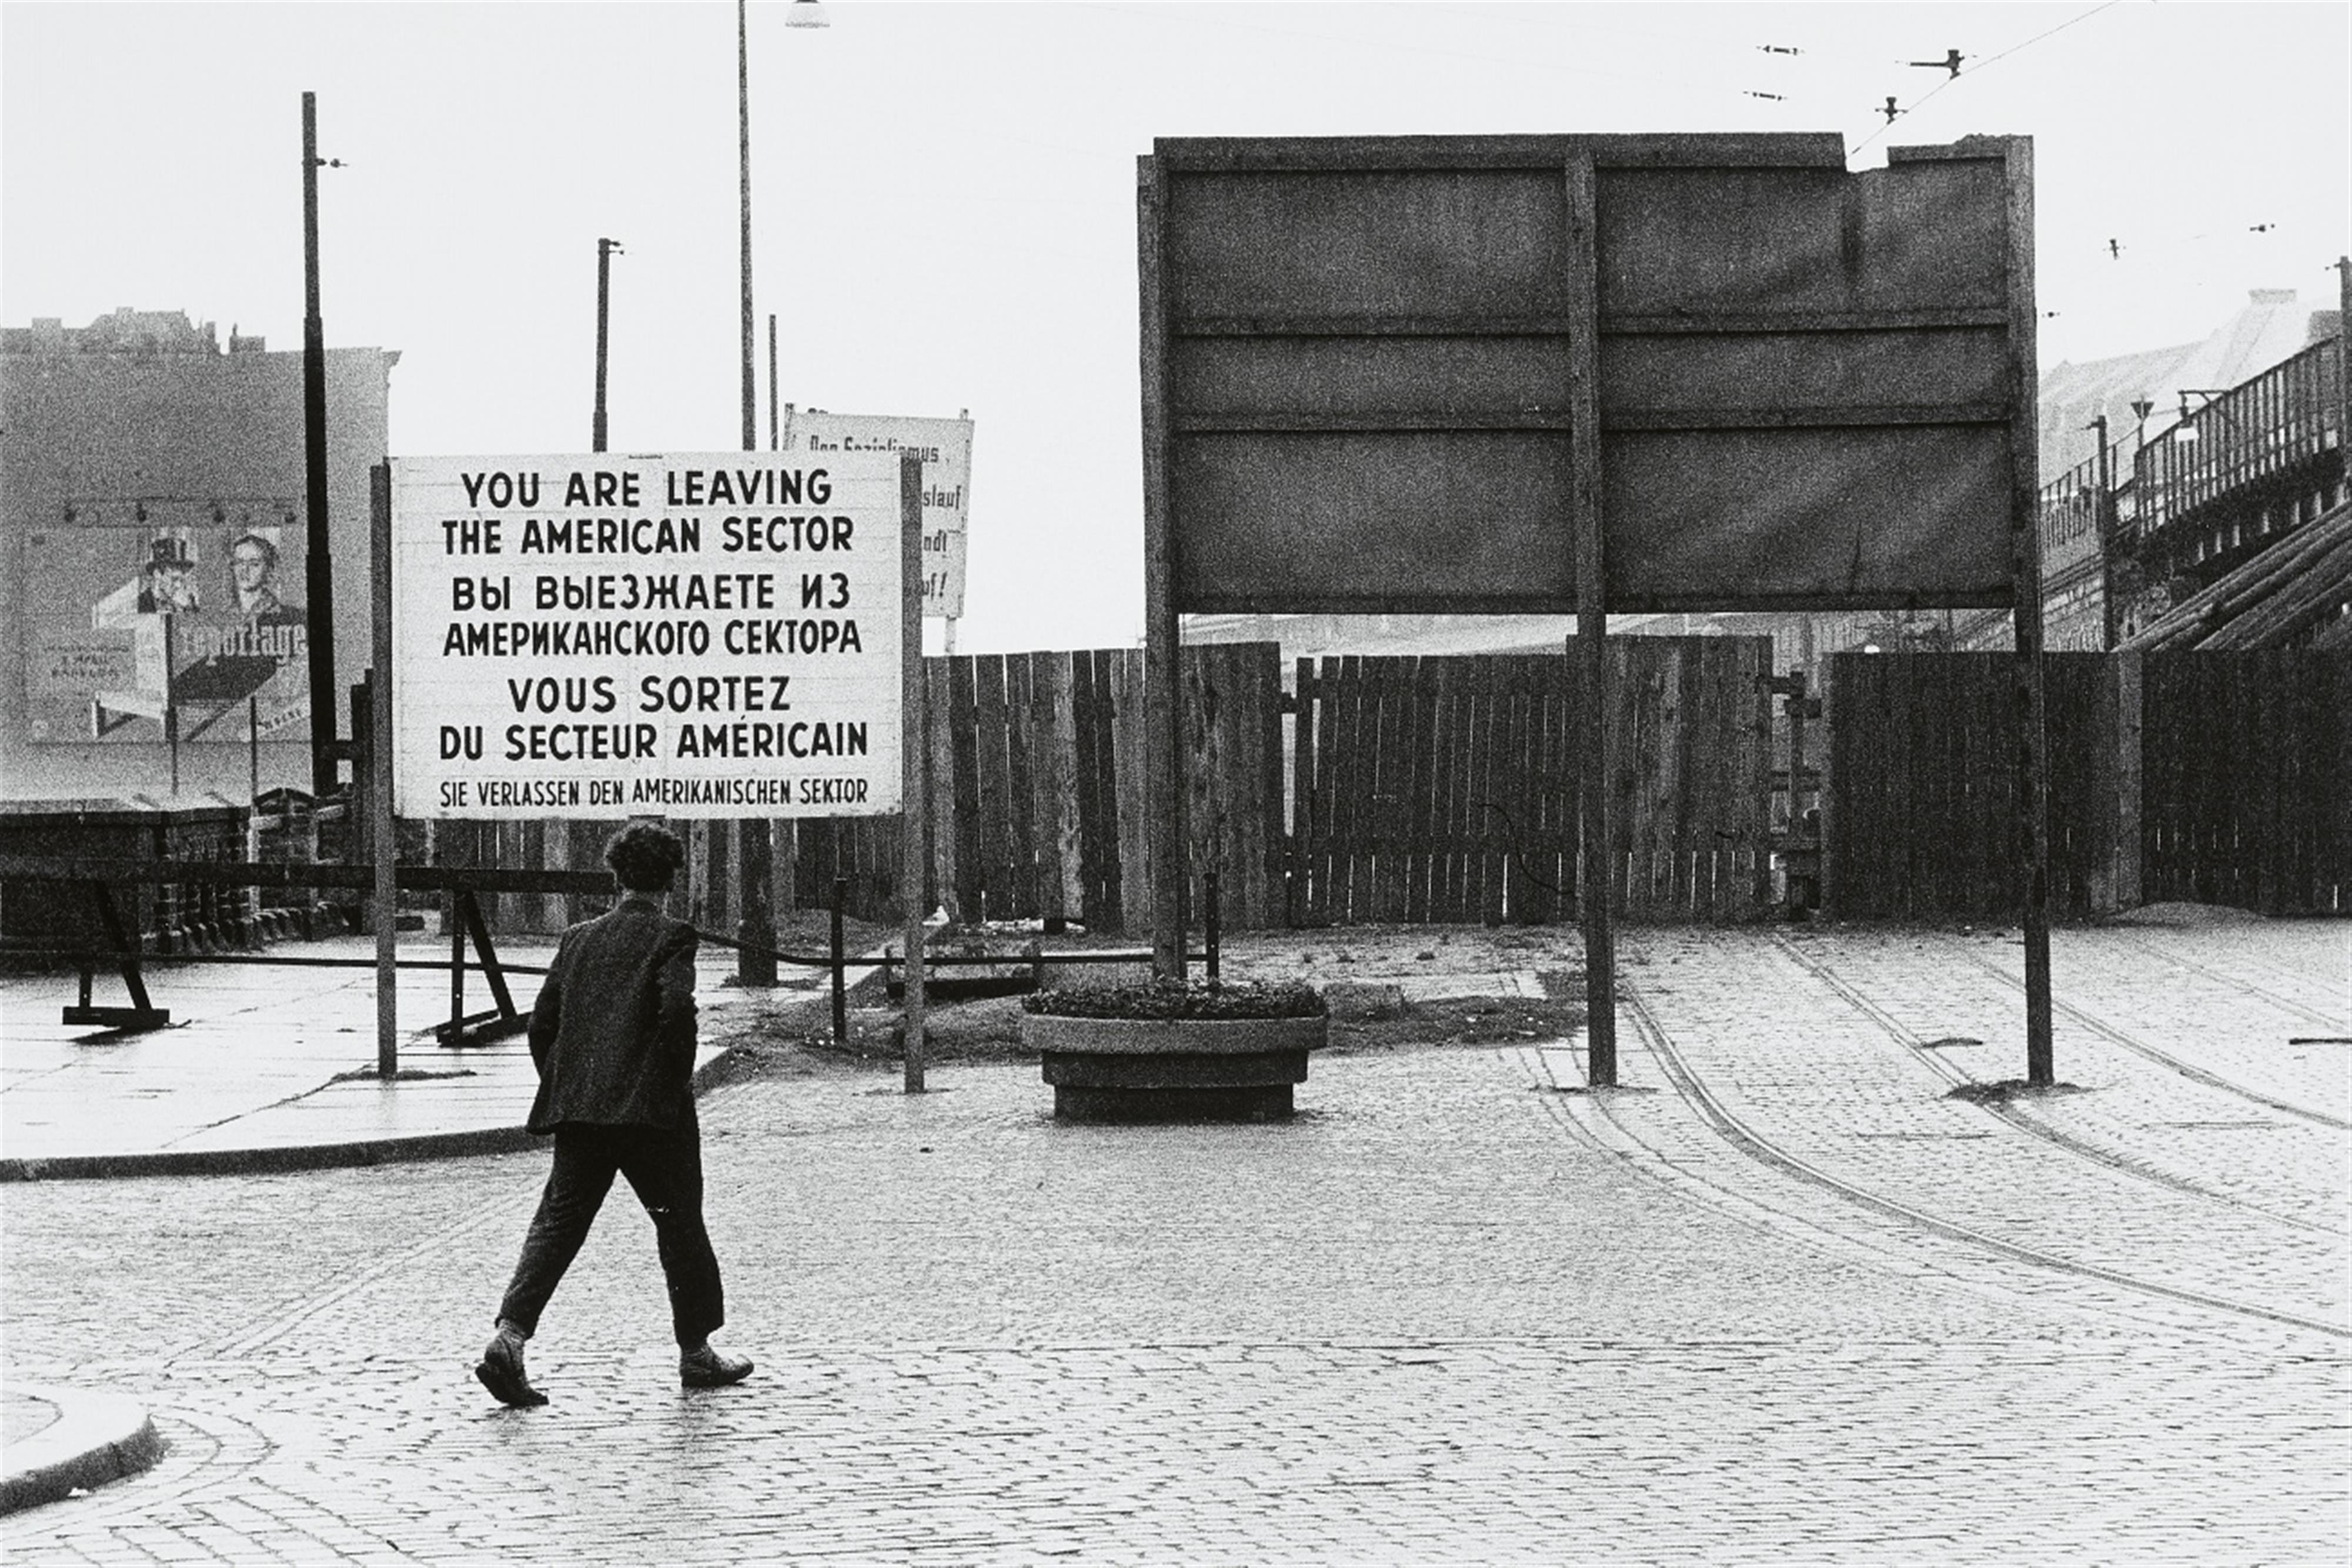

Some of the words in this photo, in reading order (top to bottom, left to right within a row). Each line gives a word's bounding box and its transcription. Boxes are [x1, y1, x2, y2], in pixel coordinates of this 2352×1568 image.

[461, 472, 539, 509] YOU
[564, 472, 640, 507] ARE
[667, 469, 831, 506] LEAVING
[923, 484, 961, 510] slauf
[442, 520, 501, 555] THE
[521, 518, 700, 555] AMERICAN
[723, 516, 853, 553] SECTOR
[453, 576, 510, 611] ВЫ
[536, 574, 773, 610] ВЫЕЗЖАЕТЕ
[801, 572, 850, 609] ИЗ
[922, 571, 947, 600] uf!
[443, 620, 710, 656] АМЕРИКАНСКОГО
[724, 619, 861, 655] СЕКТОРА
[508, 676, 616, 714] VOUS
[640, 676, 790, 713] SORTEZ
[440, 726, 483, 761] DU
[505, 724, 657, 761] SECTEUR
[677, 714, 867, 758] AMÉRICAIN
[440, 781, 467, 808] SIE
[477, 781, 579, 807] VERLASSEN
[589, 780, 623, 805] DEN
[633, 778, 790, 805] AMERIKANISCHEN
[800, 778, 868, 804] SEKTOR
